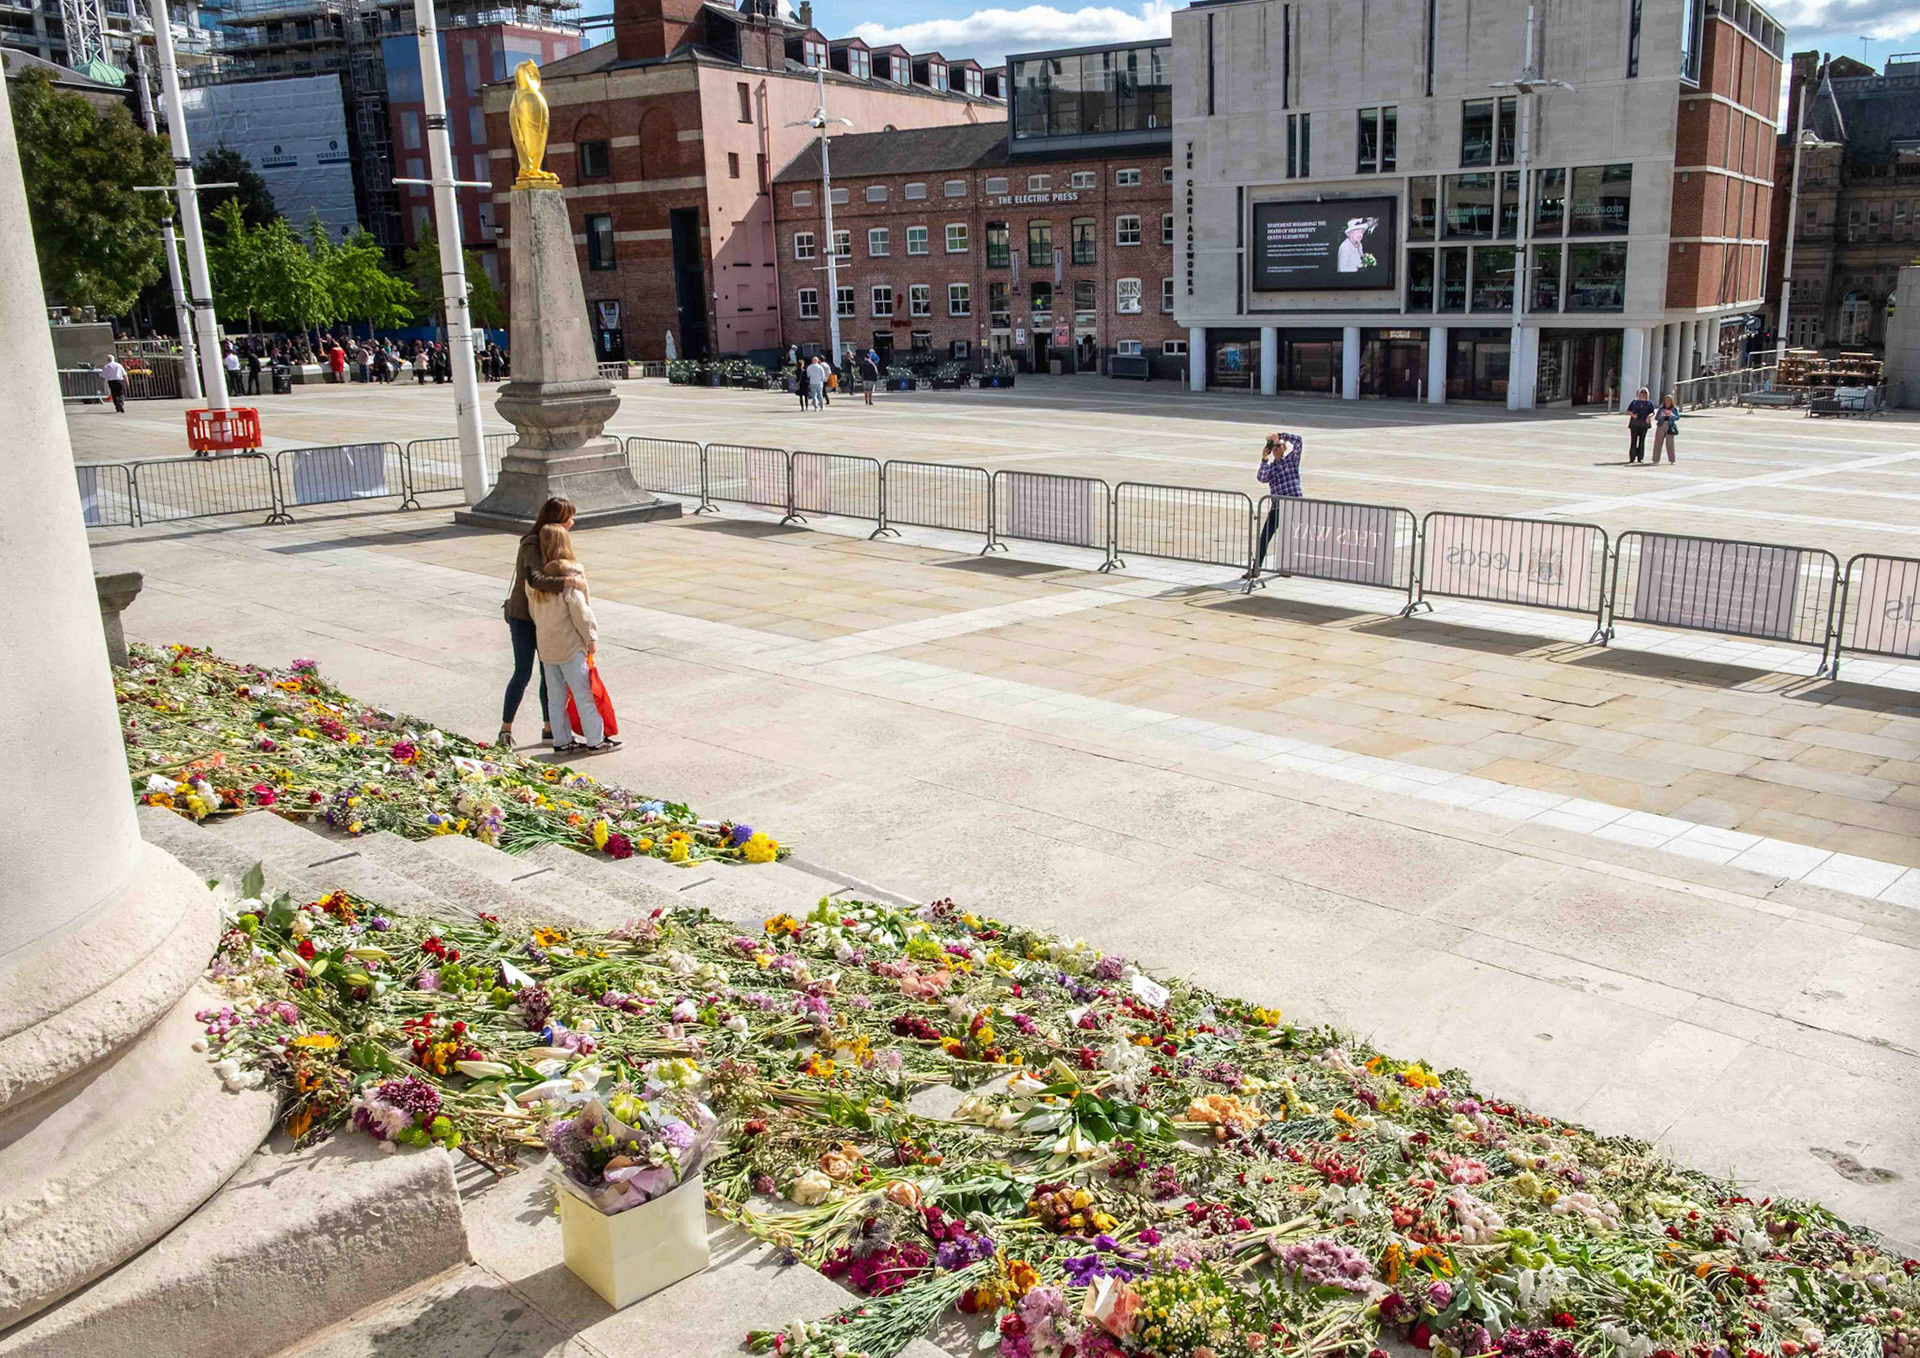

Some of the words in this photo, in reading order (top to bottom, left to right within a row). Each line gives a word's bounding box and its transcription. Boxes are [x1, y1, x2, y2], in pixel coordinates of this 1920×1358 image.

[261, 155, 297, 163] ROBERTSON
[998, 196, 1013, 205] THE
[1014, 193, 1050, 204] ELECTRIC
[1052, 192, 1078, 202] PRESS
[1412, 213, 1435, 221] Dance
[1540, 209, 1562, 217] Drama
[1186, 180, 1194, 295] CARRIAGEWORKS
[1411, 284, 1432, 293] Family
[1444, 284, 1465, 292] Events
